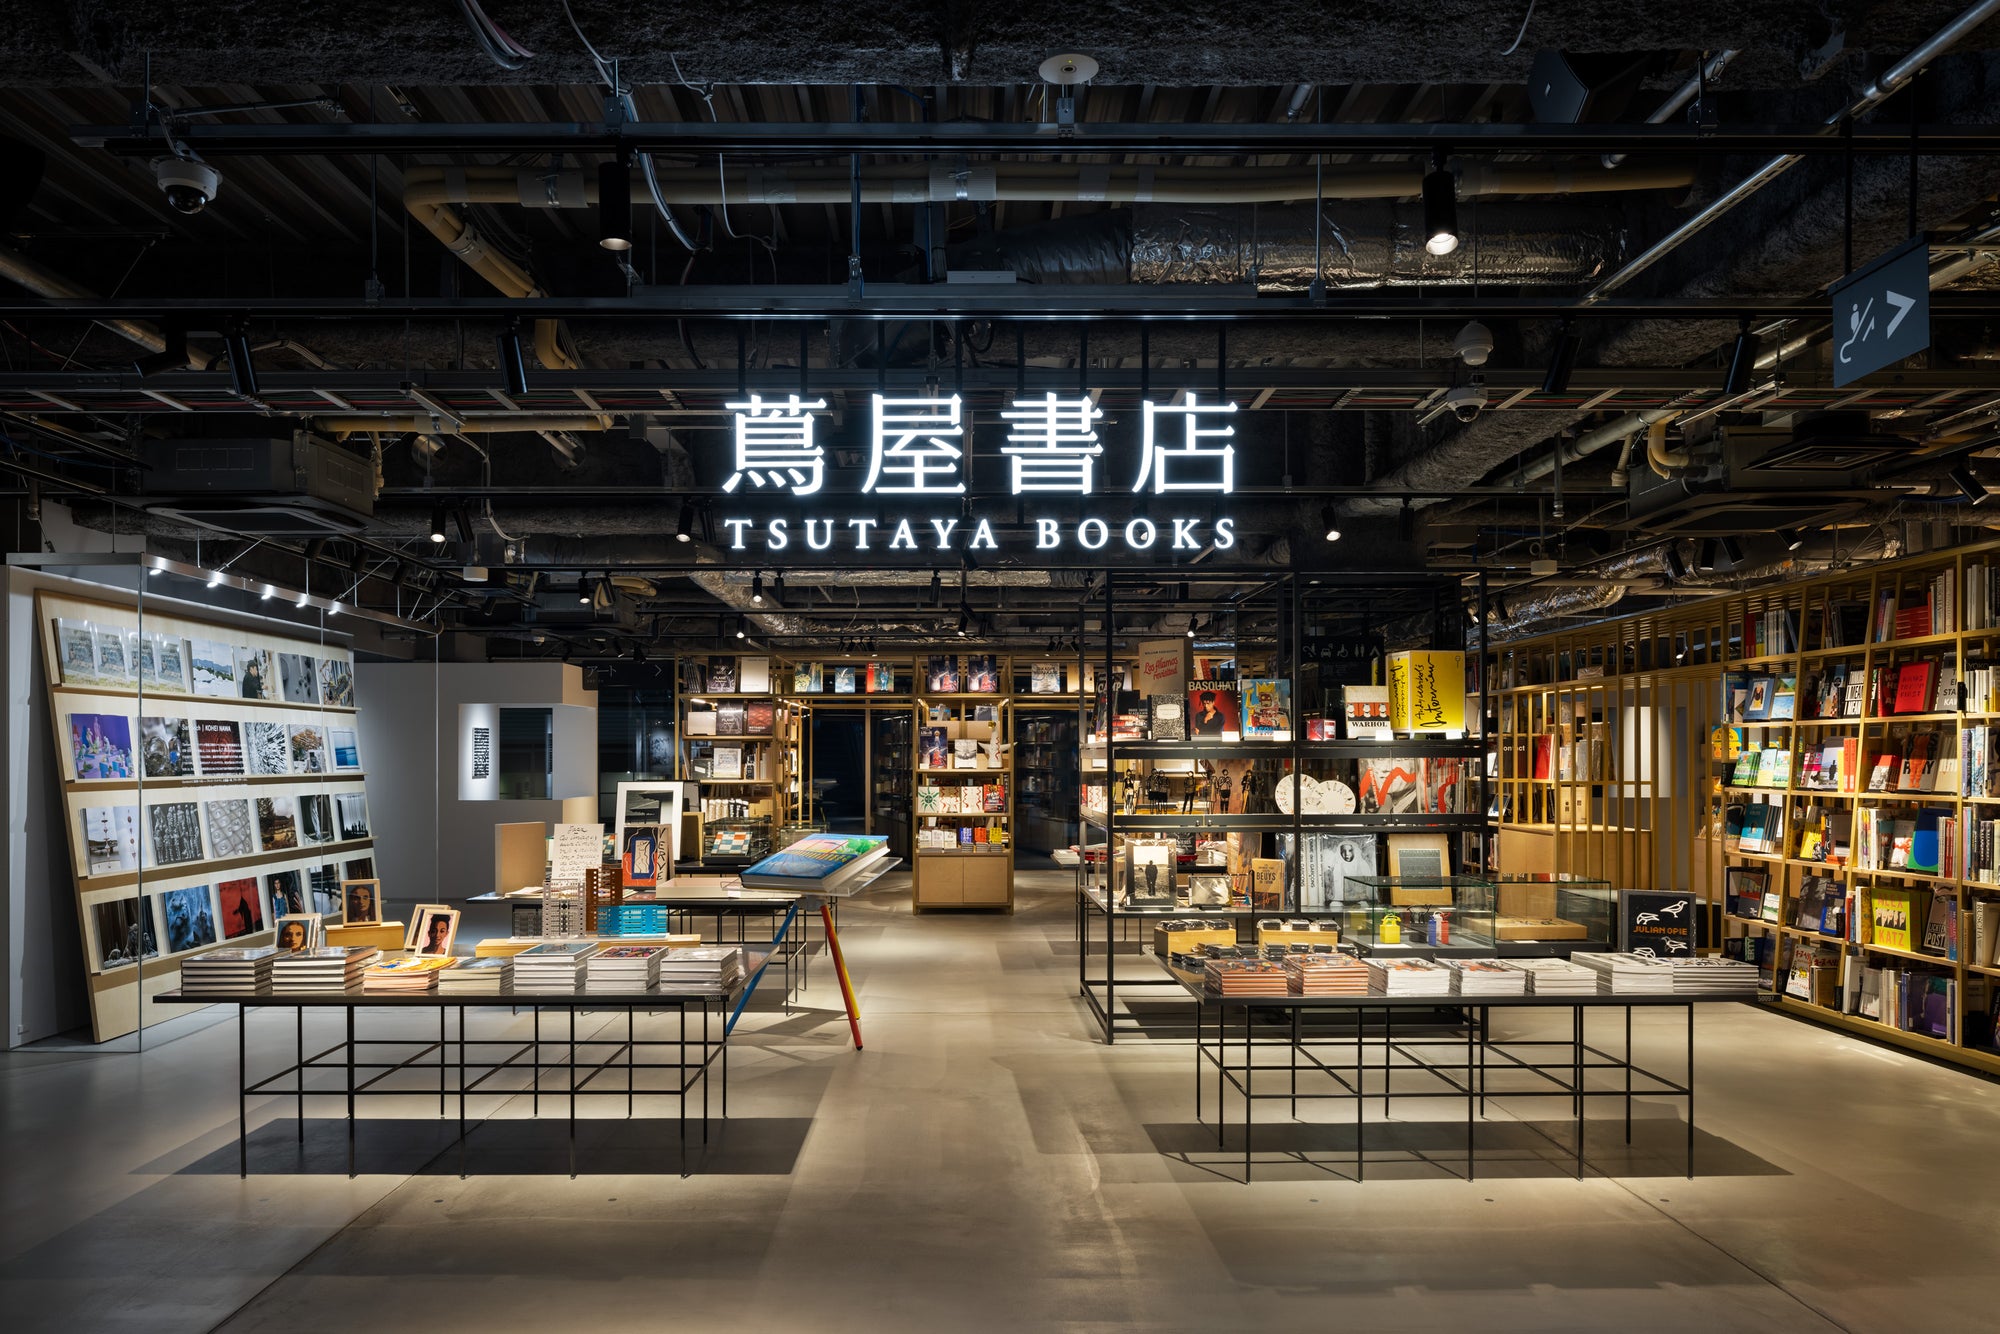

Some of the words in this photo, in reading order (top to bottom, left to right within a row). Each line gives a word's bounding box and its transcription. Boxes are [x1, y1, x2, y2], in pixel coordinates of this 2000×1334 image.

[722, 391, 1238, 496] 蔦屋書店
[724, 518, 999, 550] TSUTAYA
[1036, 518, 1236, 550] BOOKS
[586, 664, 617, 678] アート
[1188, 680, 1237, 691] BASQUIAT
[205, 724, 218, 732] KOHEI
[657, 827, 667, 881] VERVE
[1256, 872, 1276, 881] BEUYS
[1877, 891, 1904, 909] ALEX
[1633, 925, 1666, 934] JULIAN
[1667, 927, 1688, 936] OPIE
[1879, 927, 1905, 947] KATZ
